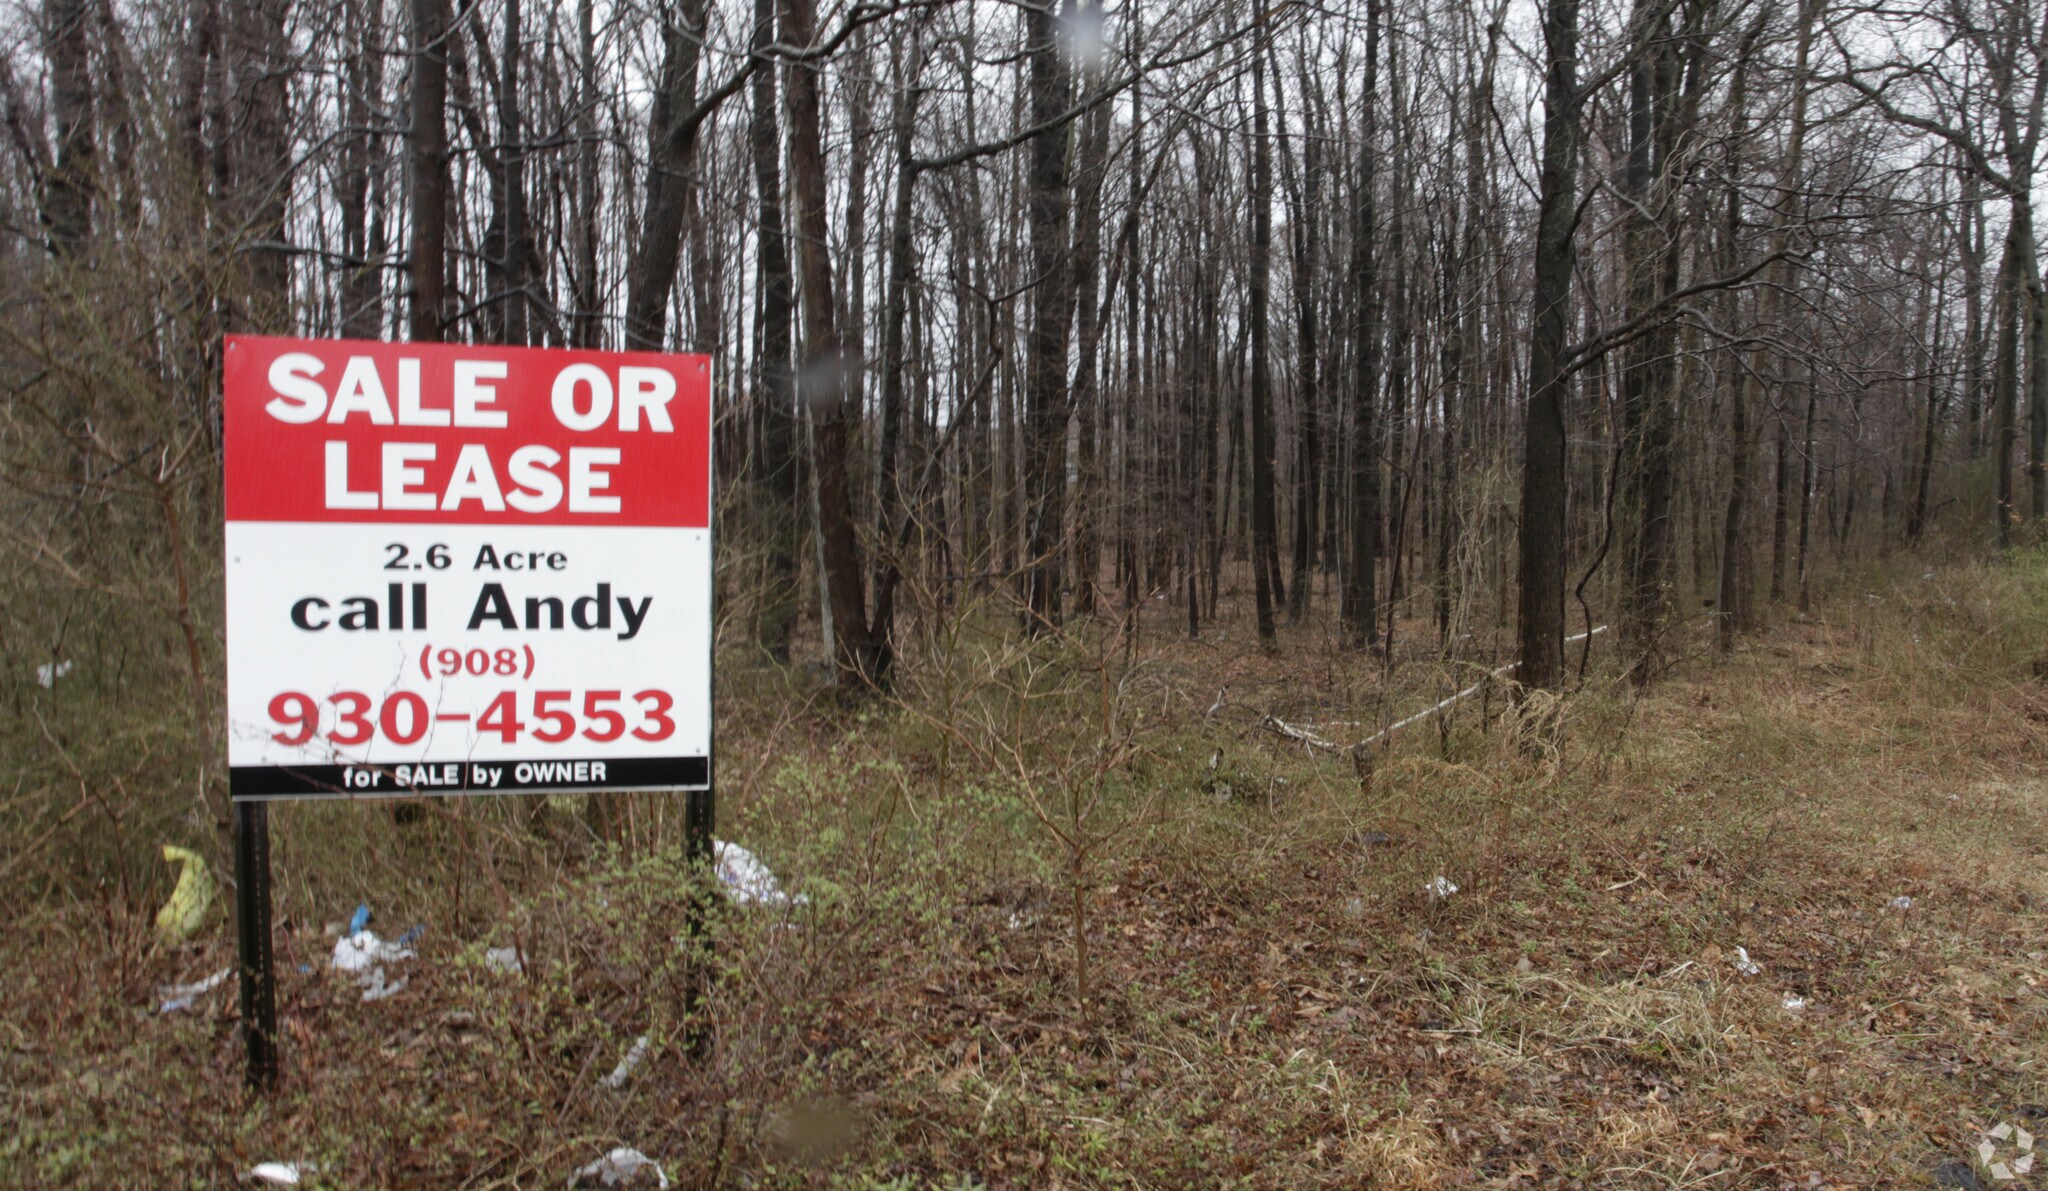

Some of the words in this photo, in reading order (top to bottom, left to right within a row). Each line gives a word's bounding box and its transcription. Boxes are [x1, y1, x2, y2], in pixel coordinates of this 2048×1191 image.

[265, 352, 509, 428] SALE
[550, 362, 677, 433] OR
[324, 440, 622, 514] LEASE
[383, 543, 453, 571] 2.6
[472, 544, 568, 571] Acre
[290, 582, 428, 632] call
[466, 582, 654, 641] Andy
[418, 643, 536, 681] (908)
[343, 767, 383, 788] for
[394, 764, 459, 786] SALE
[472, 763, 503, 786] by
[514, 761, 607, 783] OWNER
